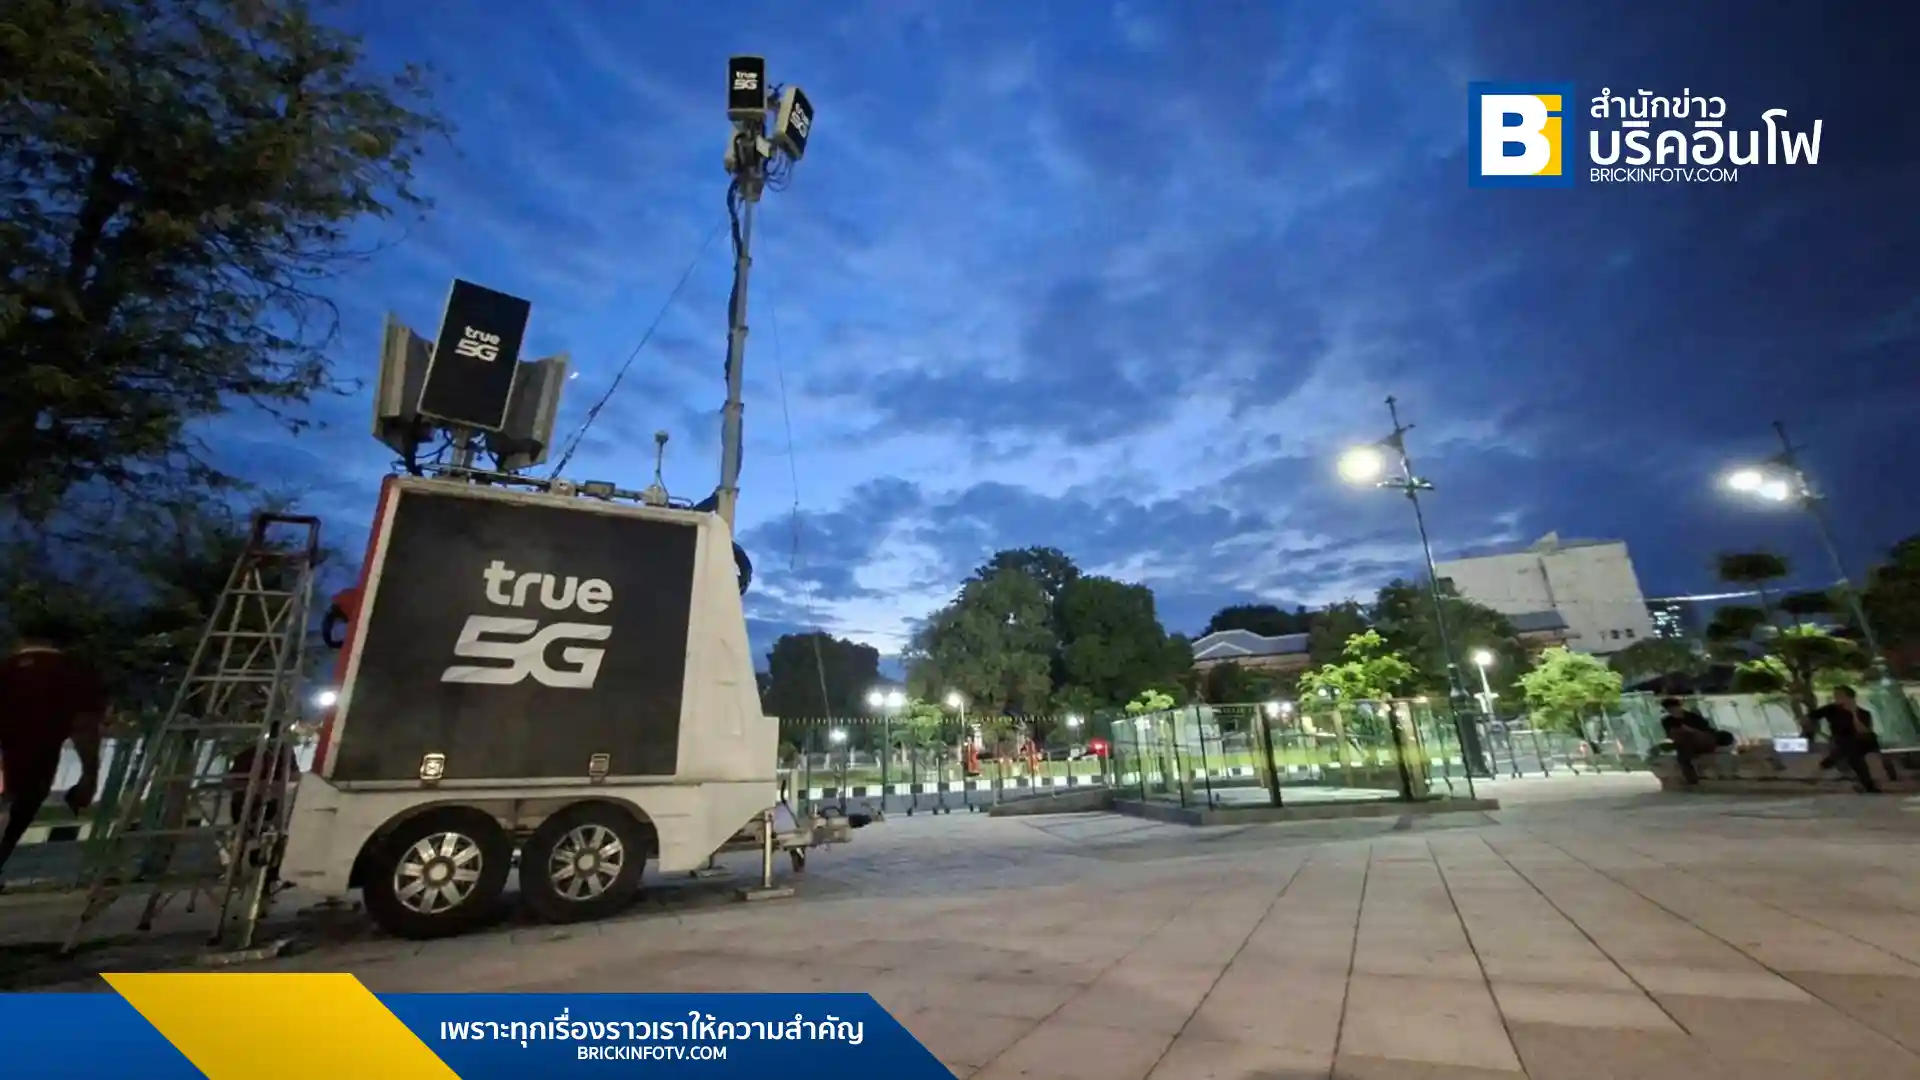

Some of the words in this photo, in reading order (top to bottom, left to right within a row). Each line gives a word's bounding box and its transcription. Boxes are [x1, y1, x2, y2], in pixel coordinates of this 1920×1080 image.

[455, 339, 500, 361] 5G
[465, 326, 500, 344] true
[483, 560, 613, 613] true
[440, 614, 613, 689] 5G
